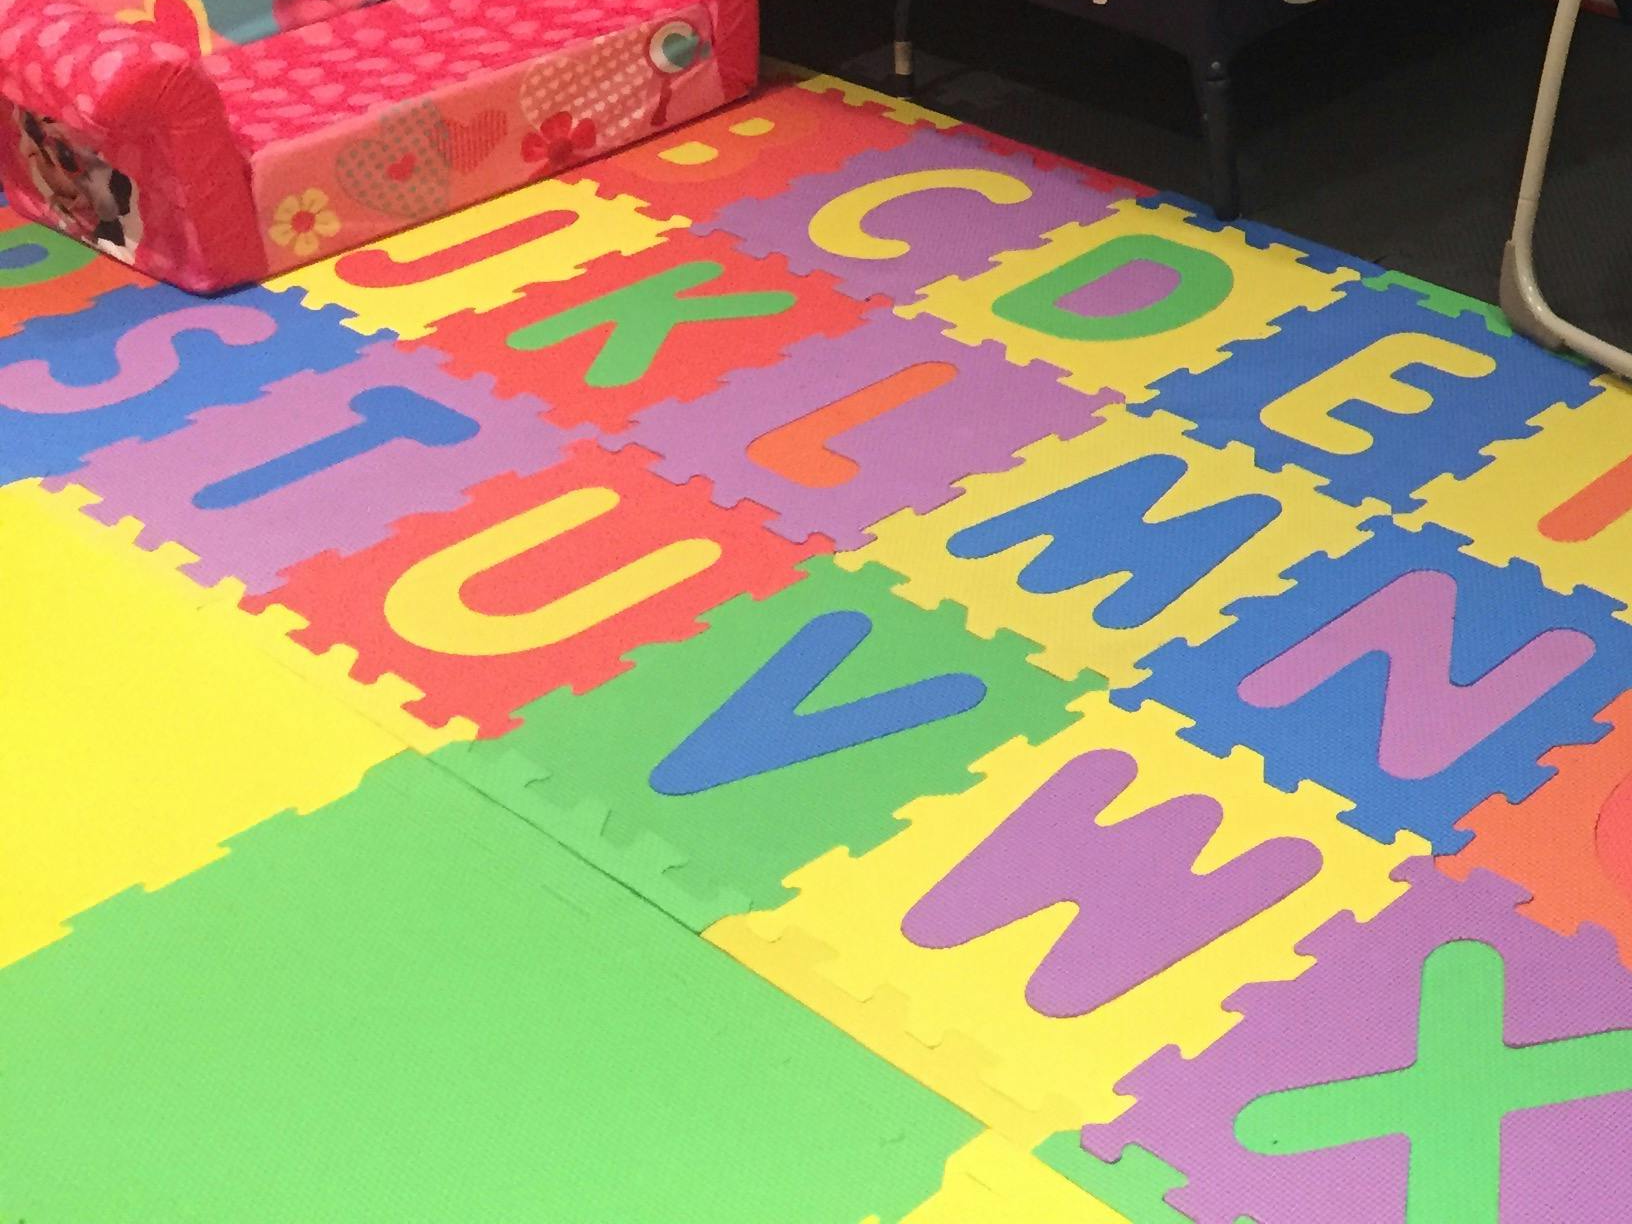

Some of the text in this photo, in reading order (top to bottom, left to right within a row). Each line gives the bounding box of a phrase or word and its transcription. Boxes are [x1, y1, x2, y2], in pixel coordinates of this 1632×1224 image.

[335, 209, 579, 289] J
[506, 261, 796, 388] K
[746, 361, 959, 489] L
[946, 454, 1282, 629] M
[1237, 569, 1596, 779] N
[808, 169, 1031, 260] C
[992, 234, 1233, 342] D
[1260, 332, 1497, 455] E
[0, 306, 278, 414] S
[192, 384, 481, 510] T
[384, 487, 722, 655] U
[648, 610, 987, 796] V
[900, 748, 1324, 1018] W
